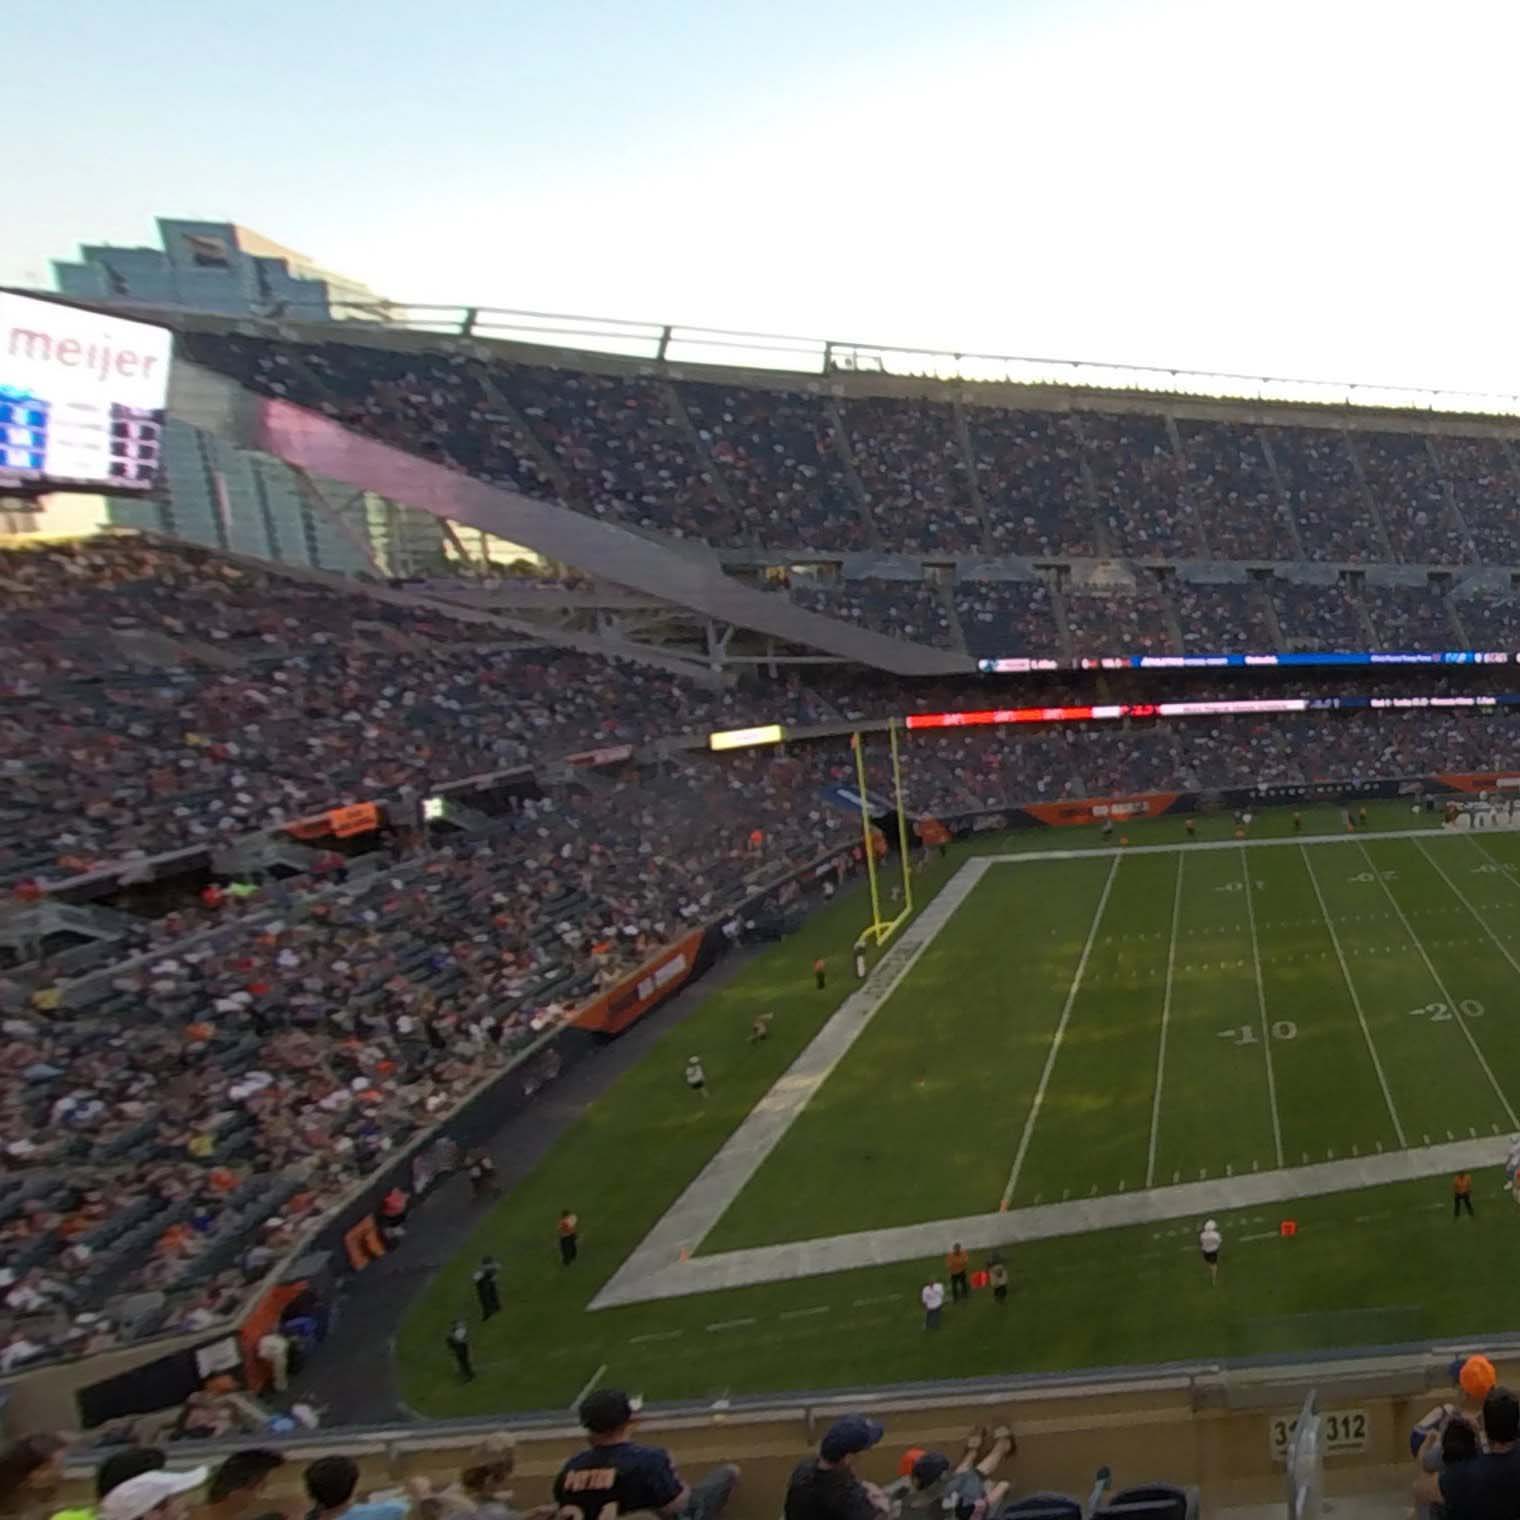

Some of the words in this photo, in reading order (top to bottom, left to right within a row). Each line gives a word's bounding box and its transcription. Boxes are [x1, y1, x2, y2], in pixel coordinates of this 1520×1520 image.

[7, 327, 159, 382] meijer
[1424, 1000, 1486, 1022] 20
[1233, 1020, 1298, 1045] 10
[1326, 1414, 1366, 1441] 312
